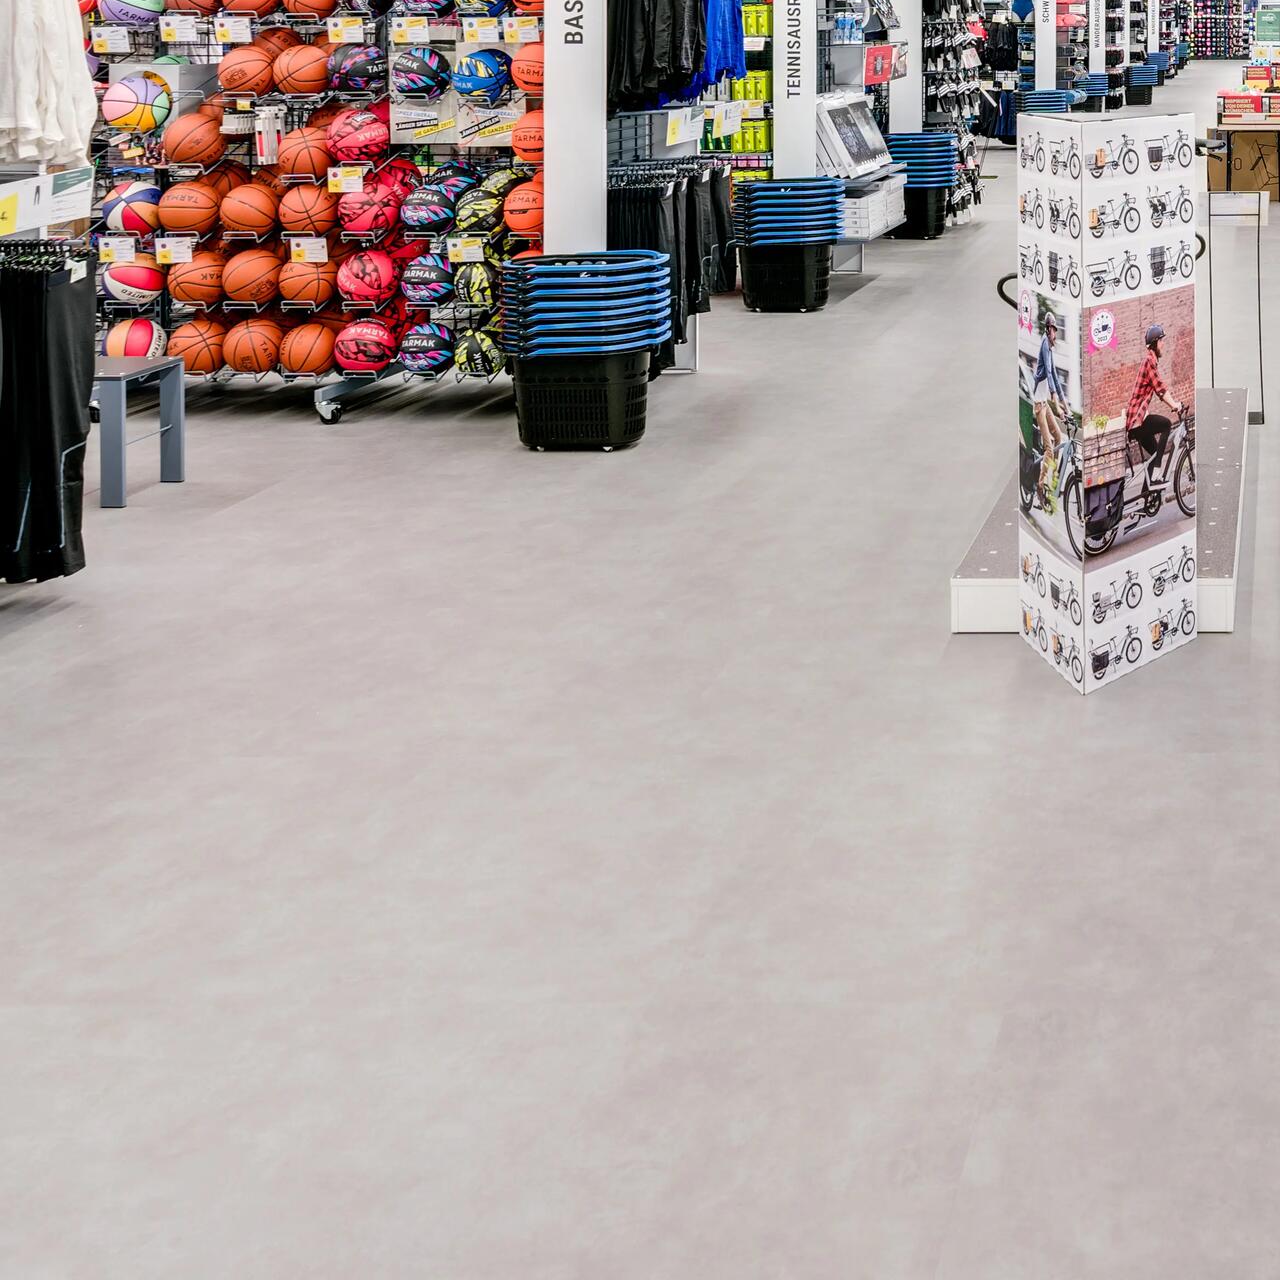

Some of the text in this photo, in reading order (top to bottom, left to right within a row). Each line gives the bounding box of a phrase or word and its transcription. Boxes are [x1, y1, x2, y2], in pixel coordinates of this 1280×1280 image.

[404, 271, 438, 280] TARMAK
[349, 326, 390, 340] TARMAK
[402, 339, 436, 348] TARMAK
